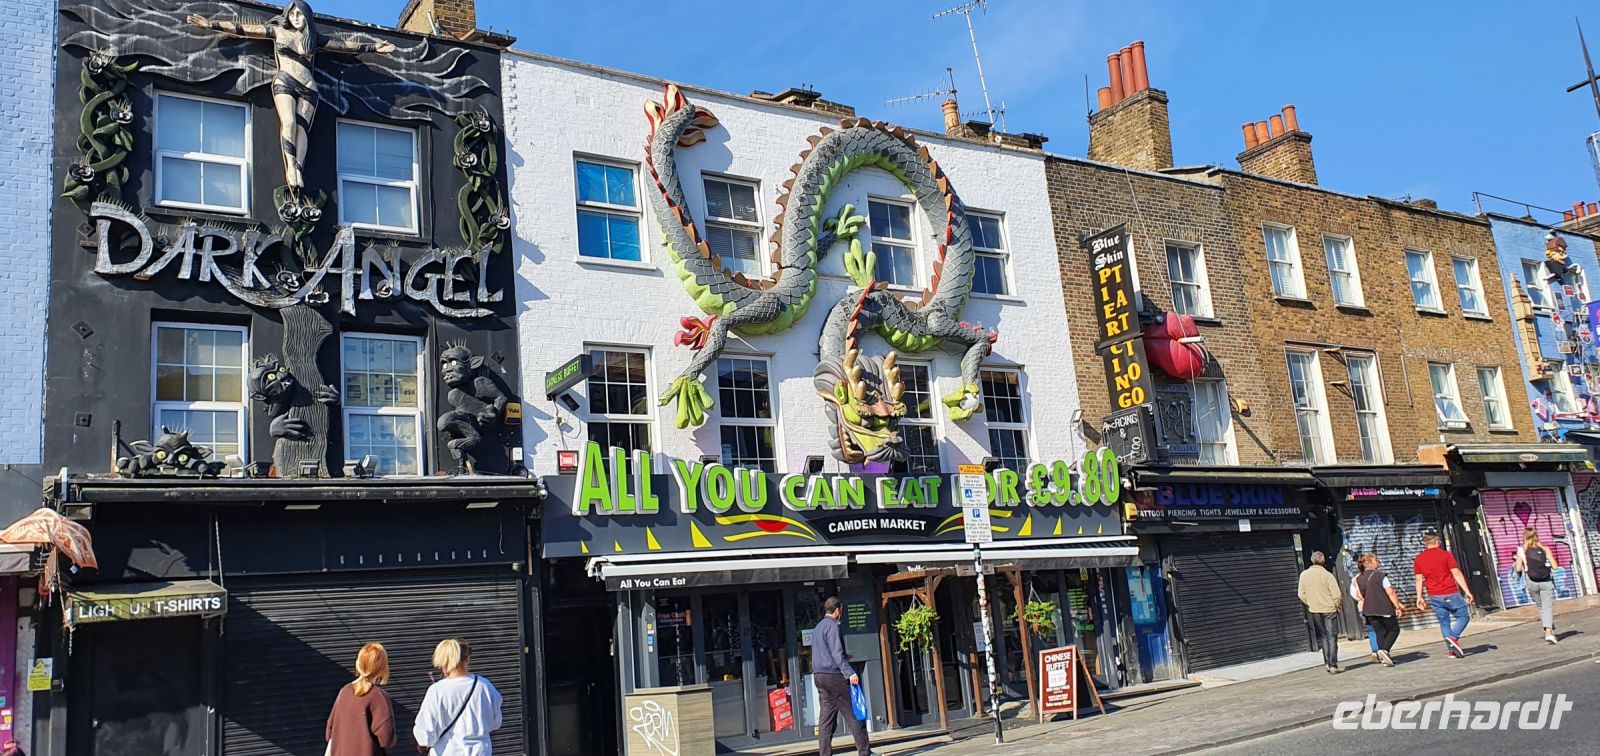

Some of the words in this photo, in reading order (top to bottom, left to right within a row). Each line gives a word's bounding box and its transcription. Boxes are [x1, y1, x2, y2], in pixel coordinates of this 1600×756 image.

[1092, 234, 1120, 254] Blue
[92, 202, 299, 308] DARK
[1095, 250, 1124, 271] Skin
[573, 440, 660, 515] ALL
[669, 459, 768, 513] YOU
[779, 473, 866, 510] CAN
[875, 475, 943, 510] EAT
[1025, 446, 1120, 506] £9.80
[1156, 484, 1225, 506] BLUE
[1229, 484, 1284, 505] SKIN
[1168, 509, 1196, 517] PIERCING
[1200, 508, 1221, 516] TIGHTS
[1224, 508, 1257, 516] JEWELLERY
[1264, 507, 1301, 515] ACCESSORIES
[828, 519, 878, 532] CAMDEN
[879, 518, 927, 532] MARKET
[620, 579, 632, 588] All
[633, 579, 651, 588] You
[653, 578, 670, 587] Can
[672, 577, 686, 586] Eat
[156, 596, 221, 613] T-SHIRTS
[1045, 652, 1071, 664] CHINESE
[1046, 661, 1070, 672] BUFFET
